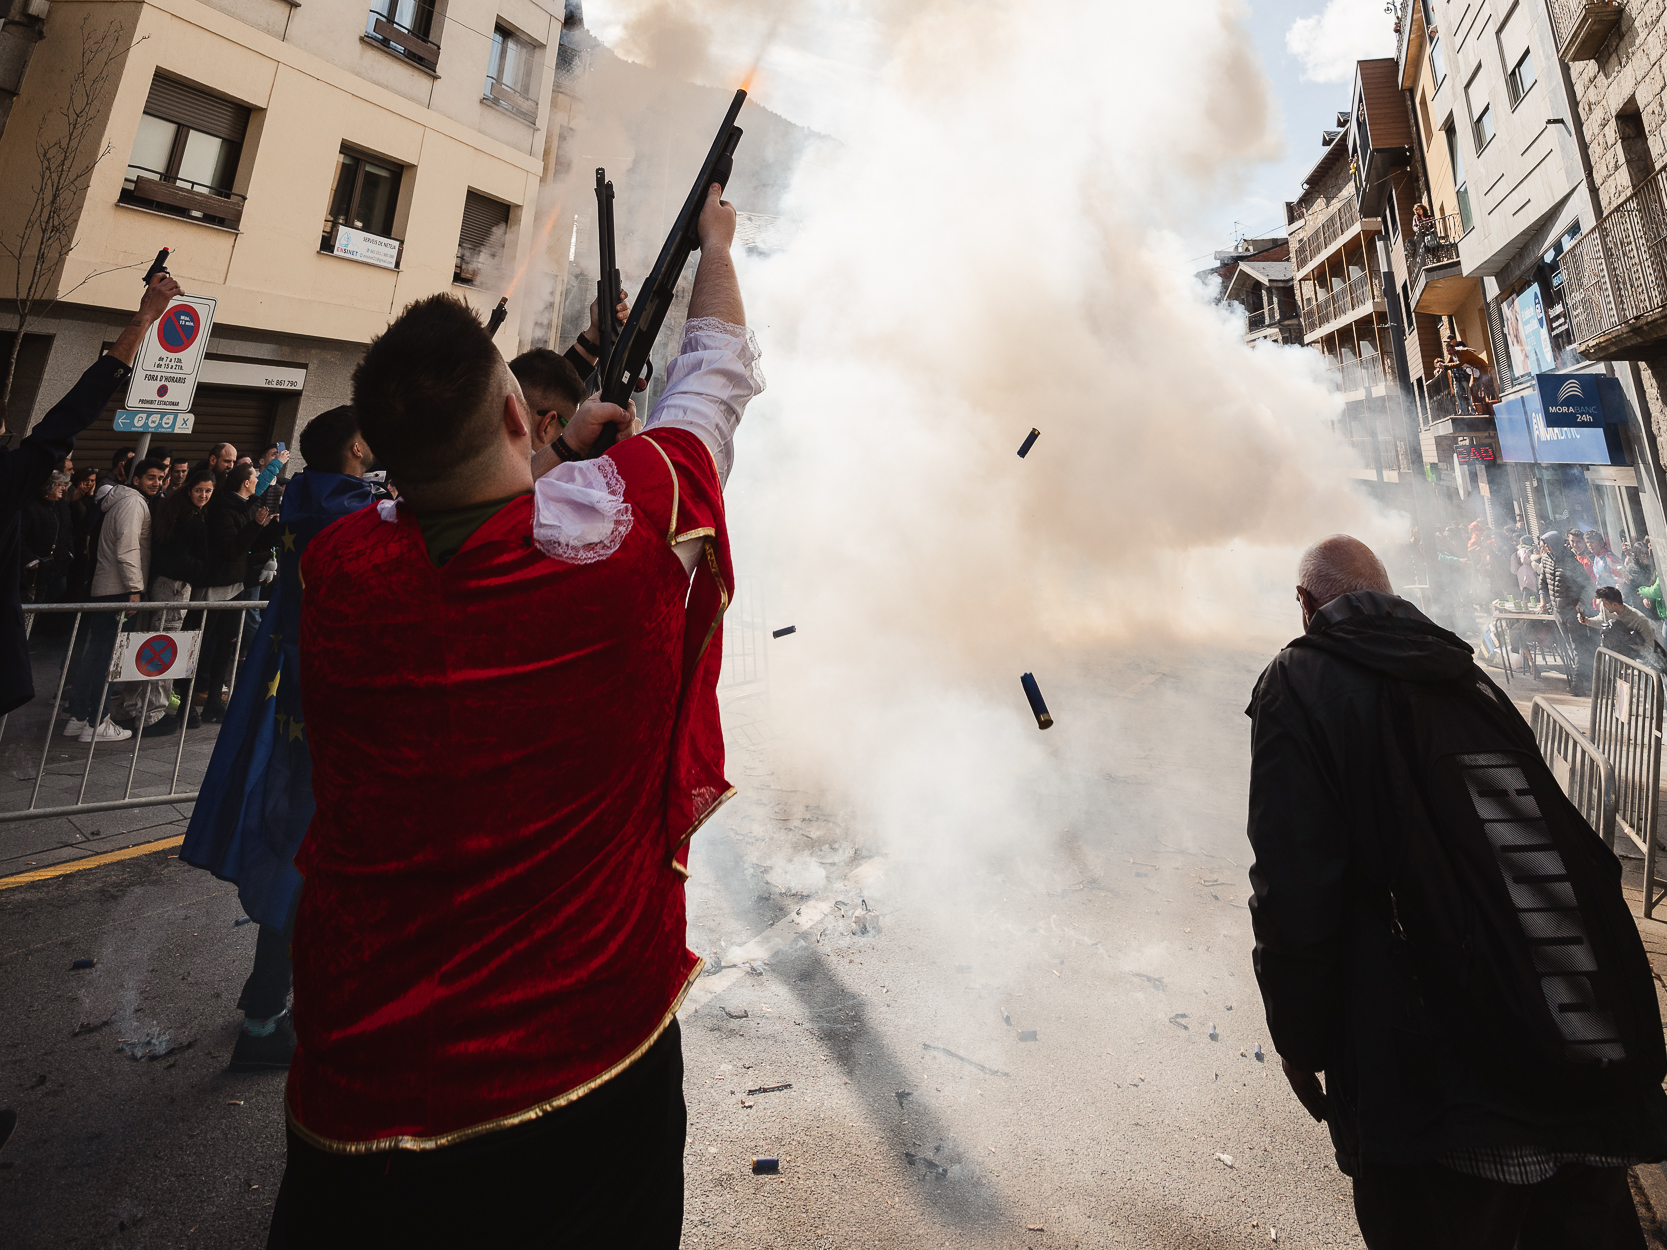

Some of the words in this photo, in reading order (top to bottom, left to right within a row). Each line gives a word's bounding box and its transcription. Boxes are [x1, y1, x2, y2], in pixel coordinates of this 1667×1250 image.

[337, 247, 358, 256] ENSINET
[144, 374, 159, 382] FORA
[159, 375, 186, 384] D'HORARIS
[1549, 406, 1598, 414] MORABANC
[1577, 414, 1593, 422] 24h
